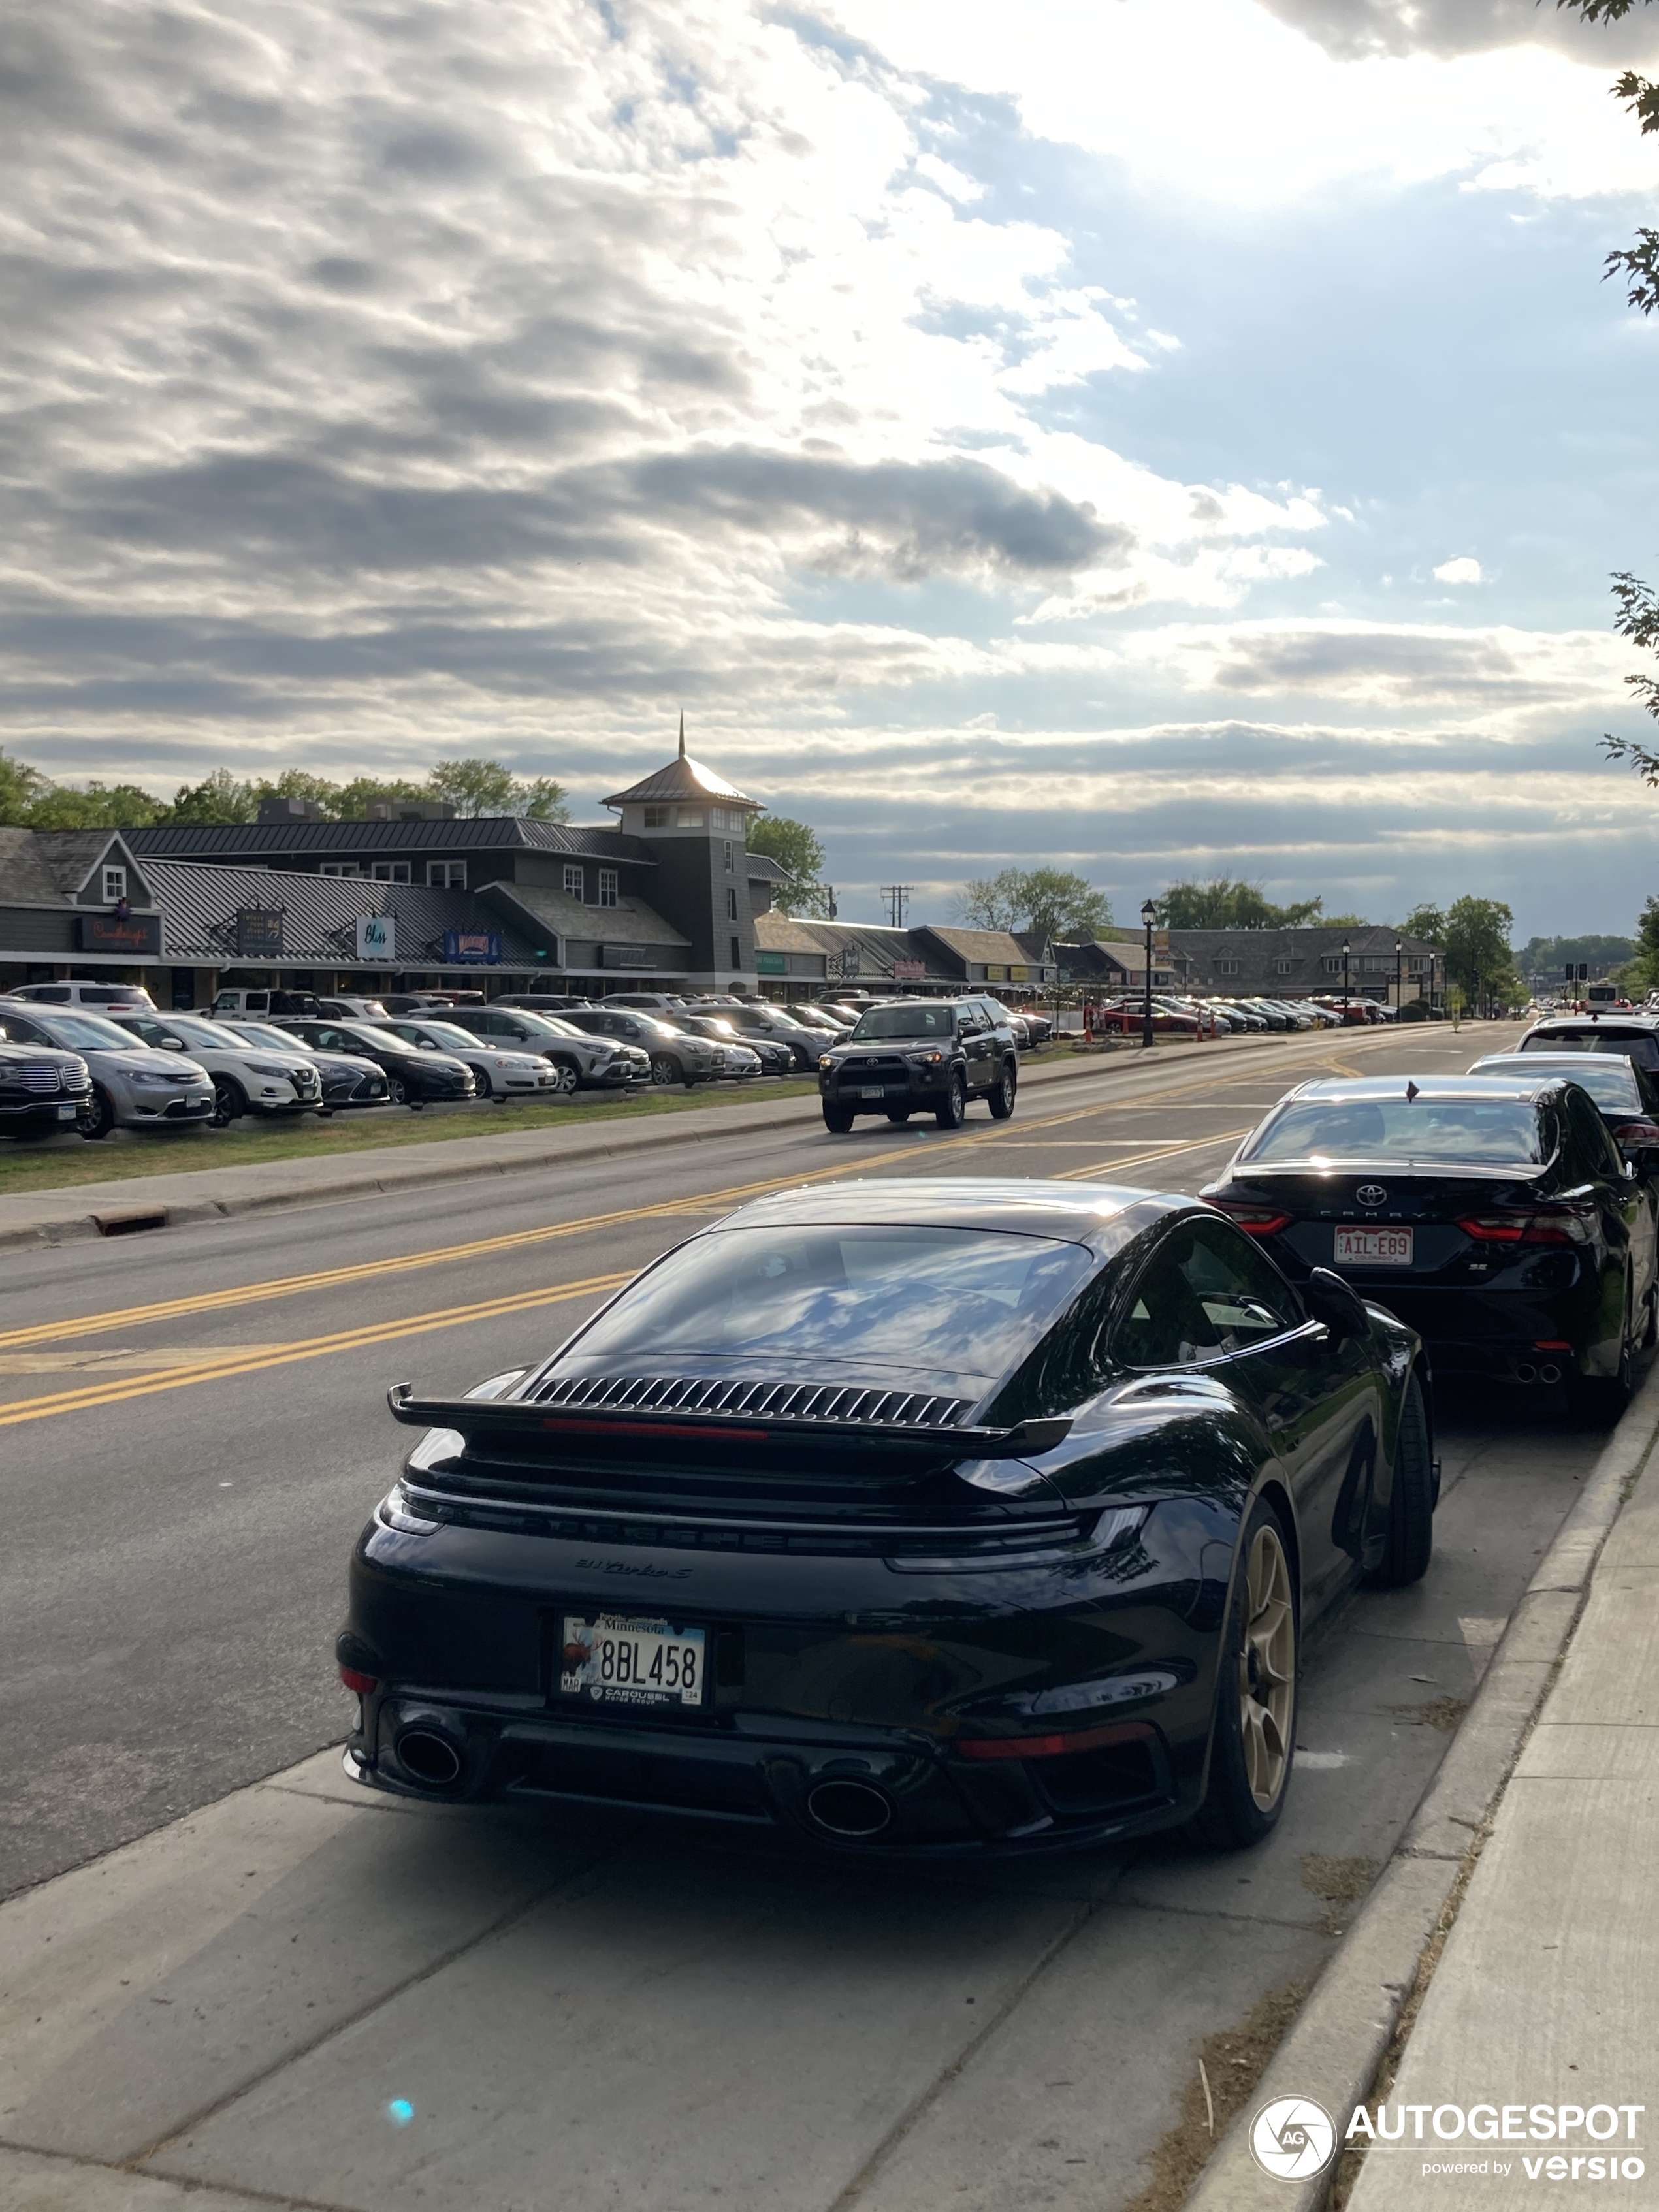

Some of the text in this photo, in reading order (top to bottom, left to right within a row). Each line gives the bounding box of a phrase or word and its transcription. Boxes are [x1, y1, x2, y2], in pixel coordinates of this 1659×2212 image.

[365, 924, 387, 944] Bliss
[604, 1619, 664, 1635] Minnesota
[562, 1678, 579, 1691] MAR
[605, 1688, 670, 1702] CAROUSEL
[631, 1697, 656, 1705] GROUP
